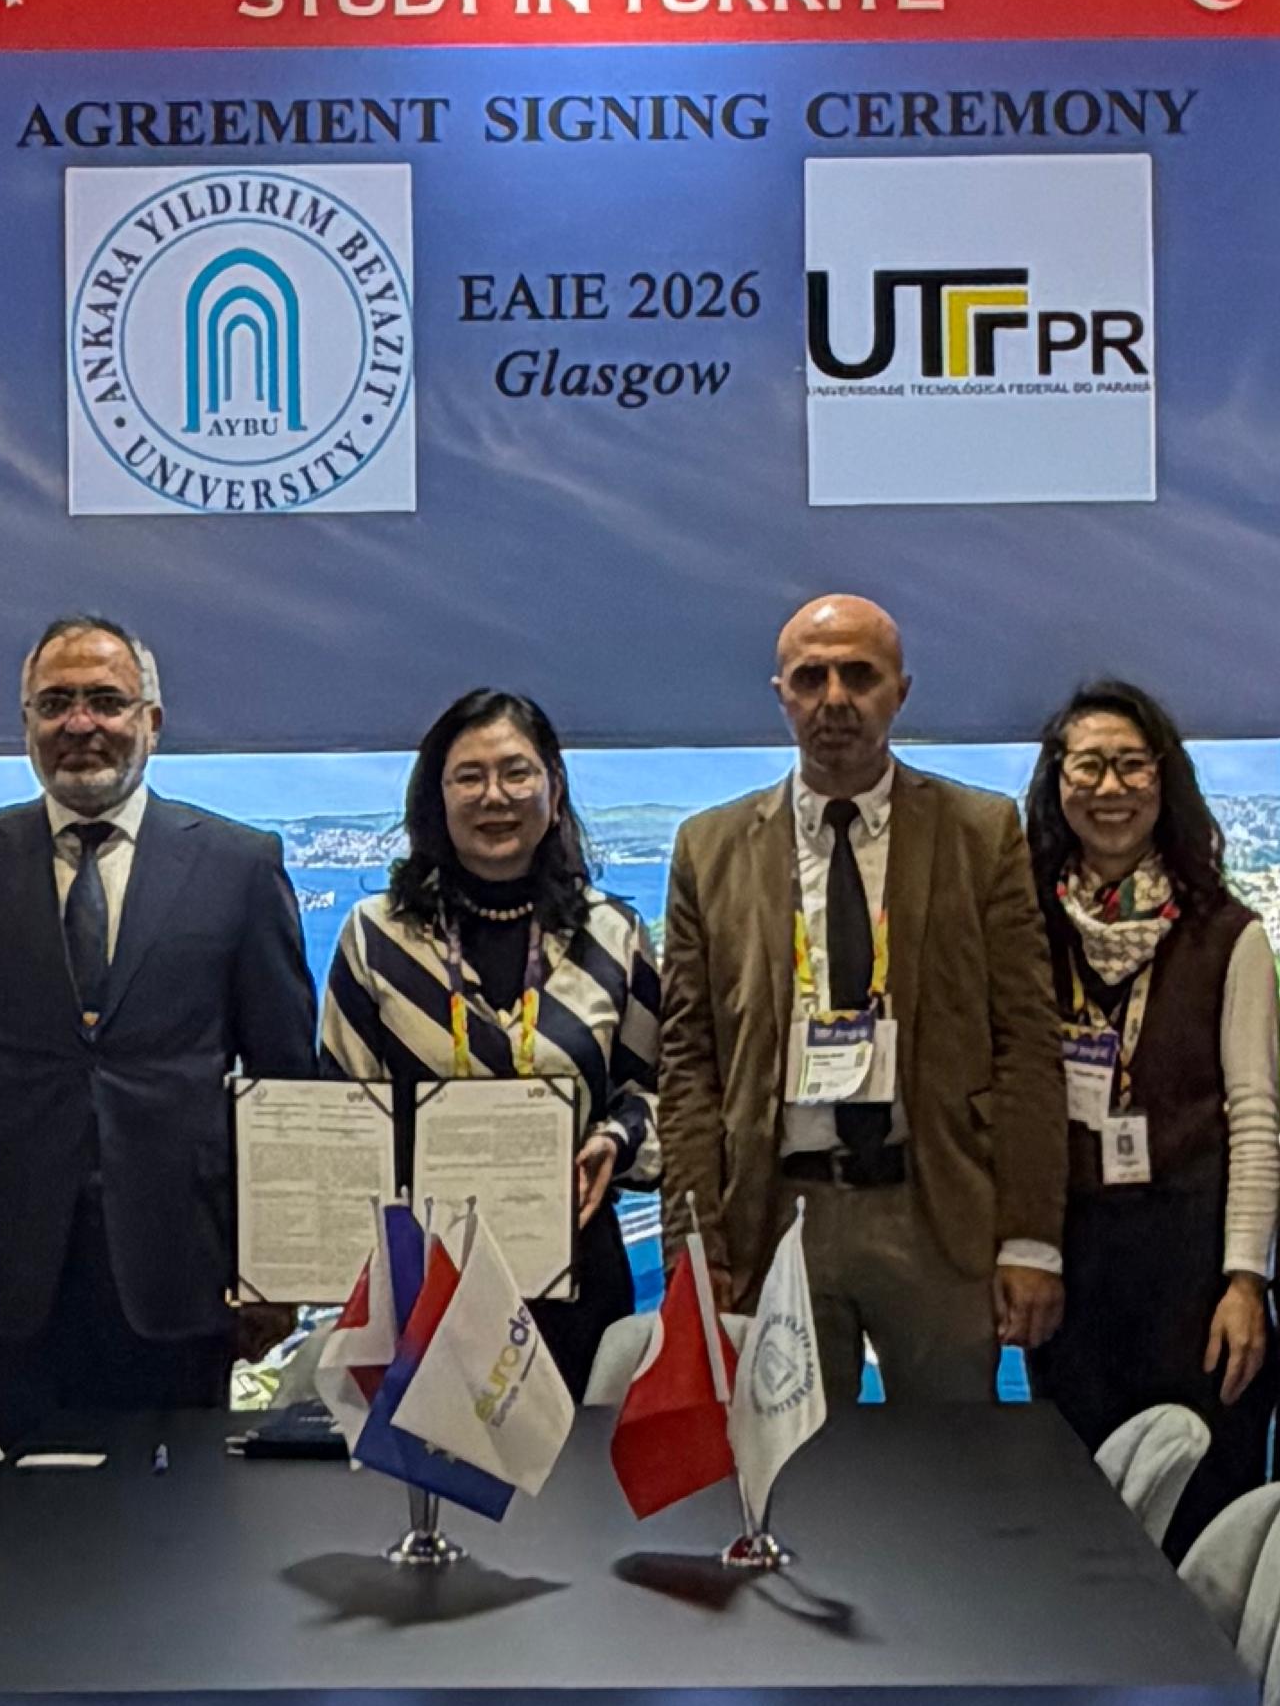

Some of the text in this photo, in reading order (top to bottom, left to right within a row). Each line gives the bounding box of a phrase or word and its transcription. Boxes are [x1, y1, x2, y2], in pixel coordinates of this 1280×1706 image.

[17, 89, 1200, 148] AGREEMENT SIGNING CEREMONY
[81, 180, 406, 407] ANKARA YILDIRIM BEYAZIT
[458, 269, 761, 322] EAIE 2026
[494, 347, 731, 409] Glasgow
[1008, 382, 1069, 394] FEDERAL
[207, 417, 281, 437] AYBU
[124, 430, 365, 511] UNIVERSITY
